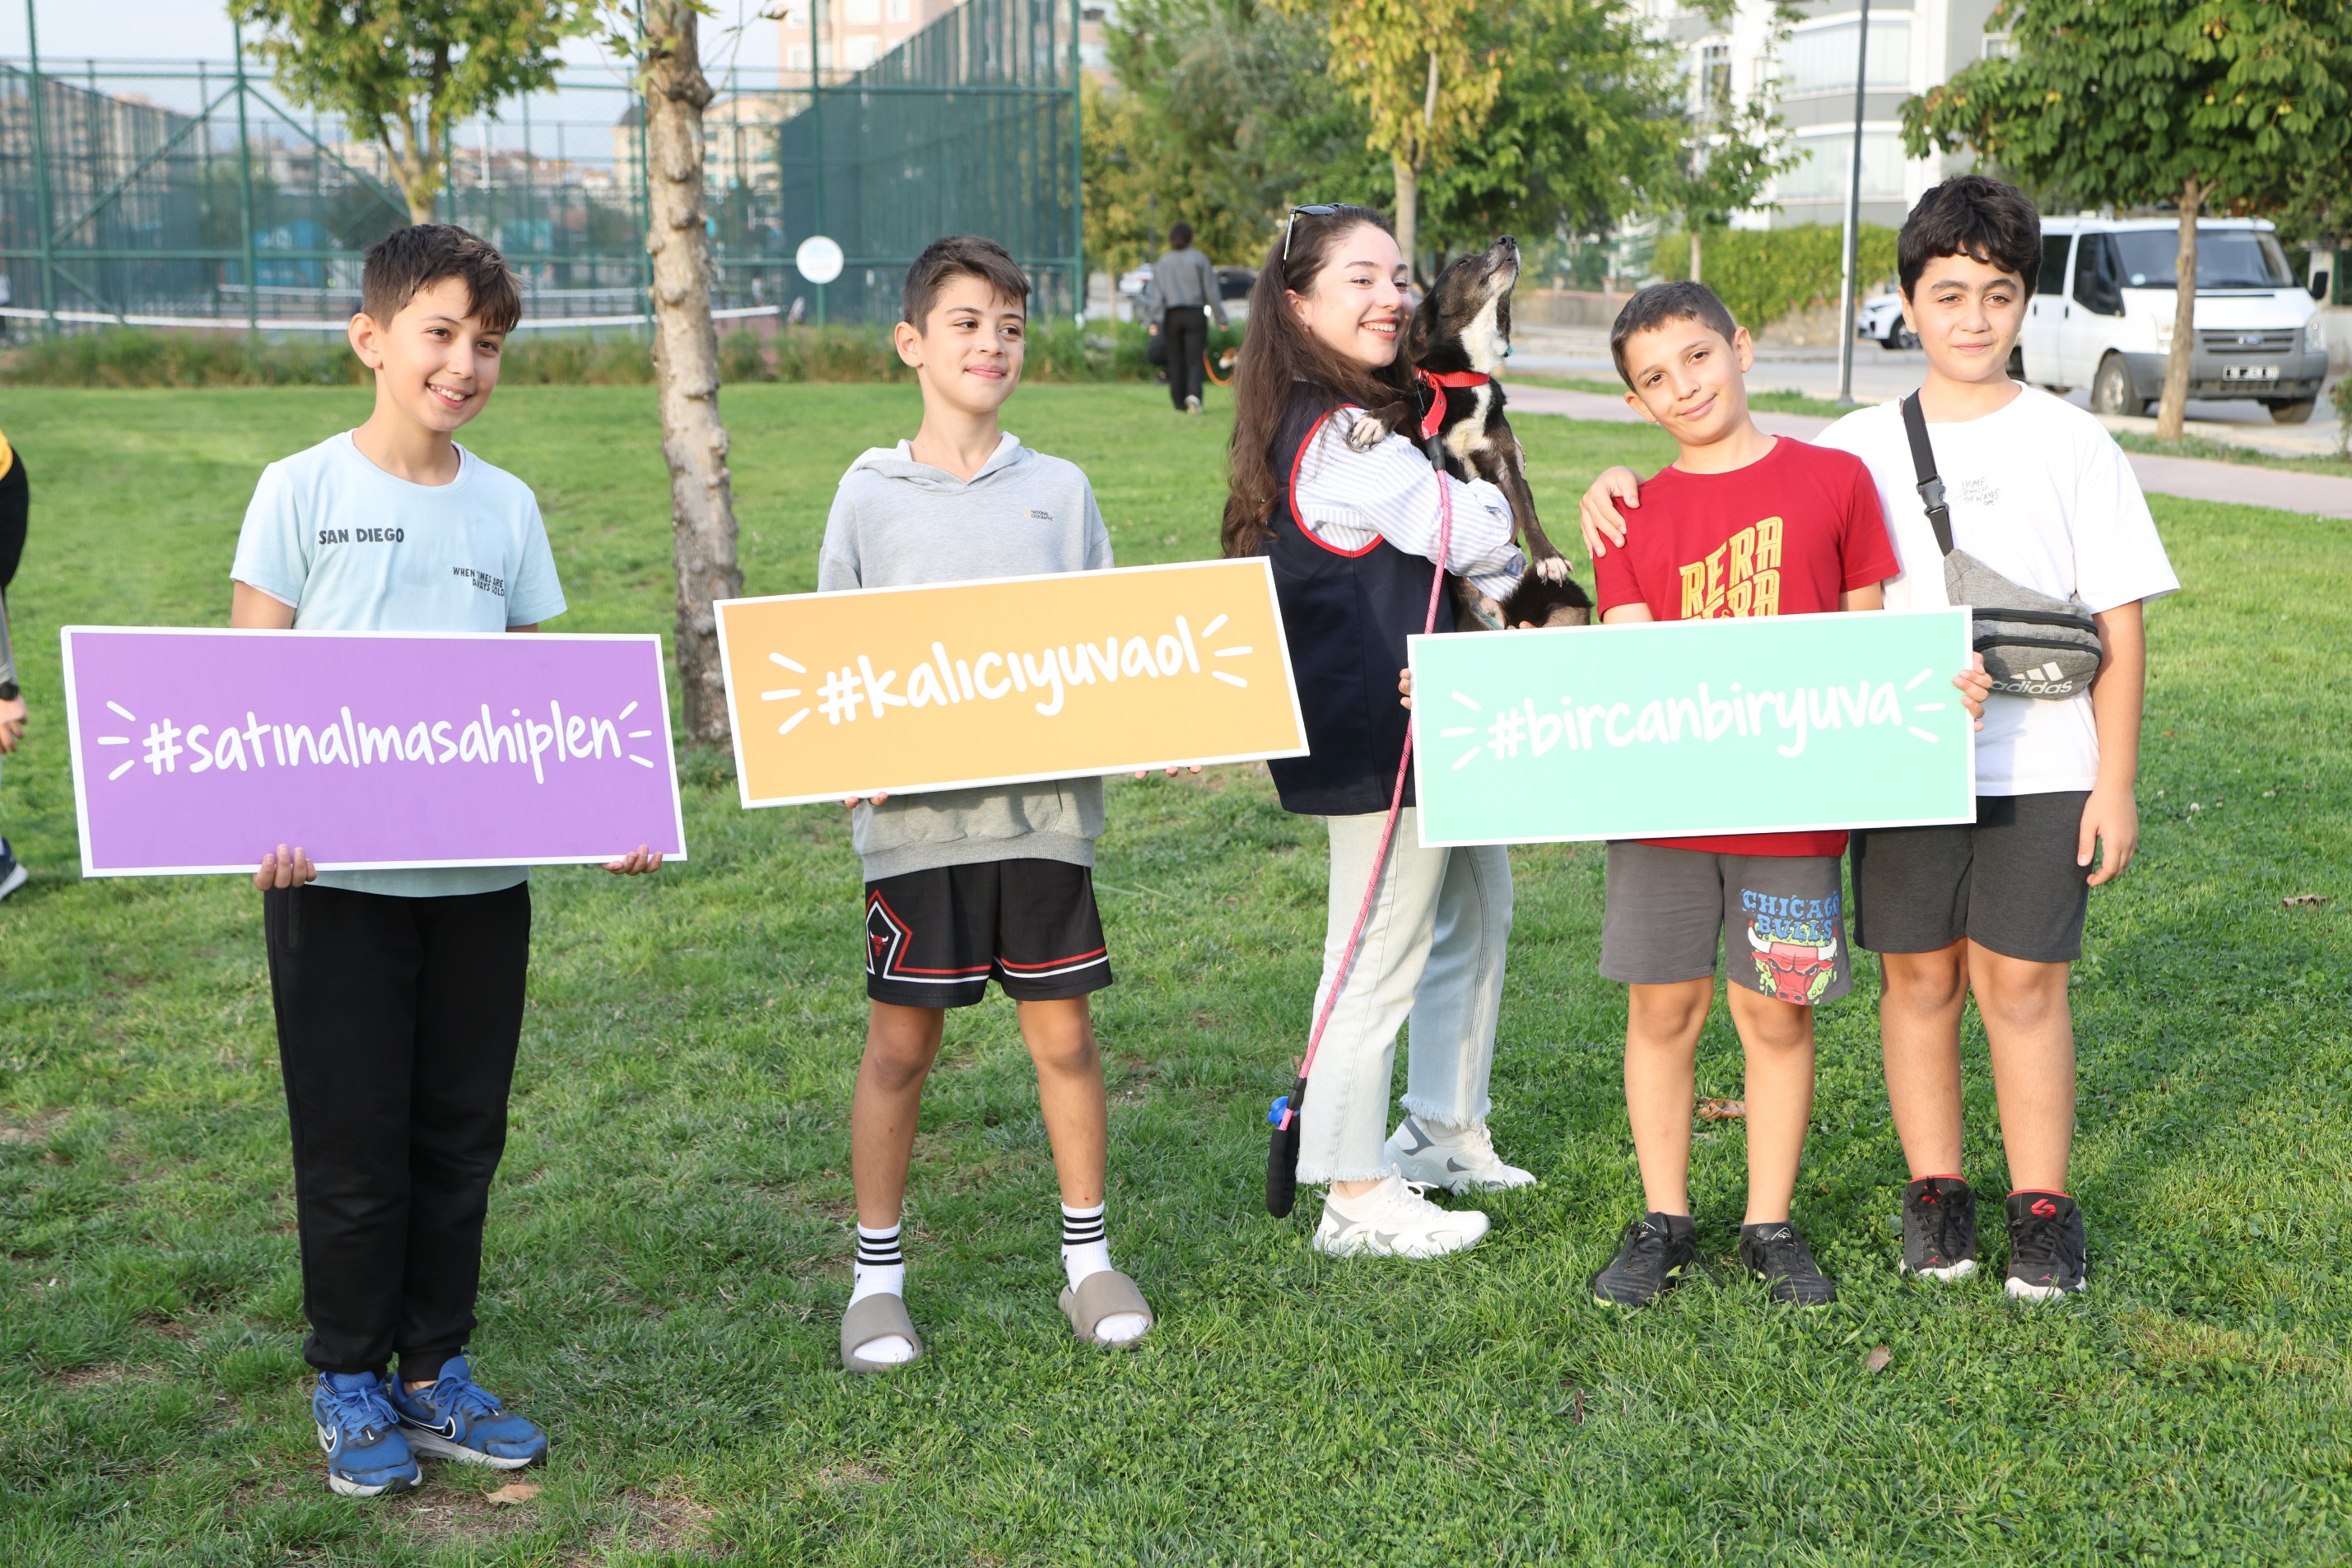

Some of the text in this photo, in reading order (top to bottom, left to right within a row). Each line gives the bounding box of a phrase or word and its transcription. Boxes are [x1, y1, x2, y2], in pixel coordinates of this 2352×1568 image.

[1962, 477, 1986, 489] HOME
[1976, 488, 2000, 501] WAVES
[319, 528, 405, 545] SAN DIEGO
[453, 566, 476, 578] WHEN
[492, 577, 504, 589] ARE
[817, 615, 1200, 725] #kalıcıyuvaol
[1991, 679, 2074, 696] adidas
[1487, 681, 1903, 761] #bircanbiryuva
[142, 700, 622, 785] #satınalmasahiplen
[1741, 890, 1841, 919] CHICAGO
[1756, 914, 1833, 942] BULLS
